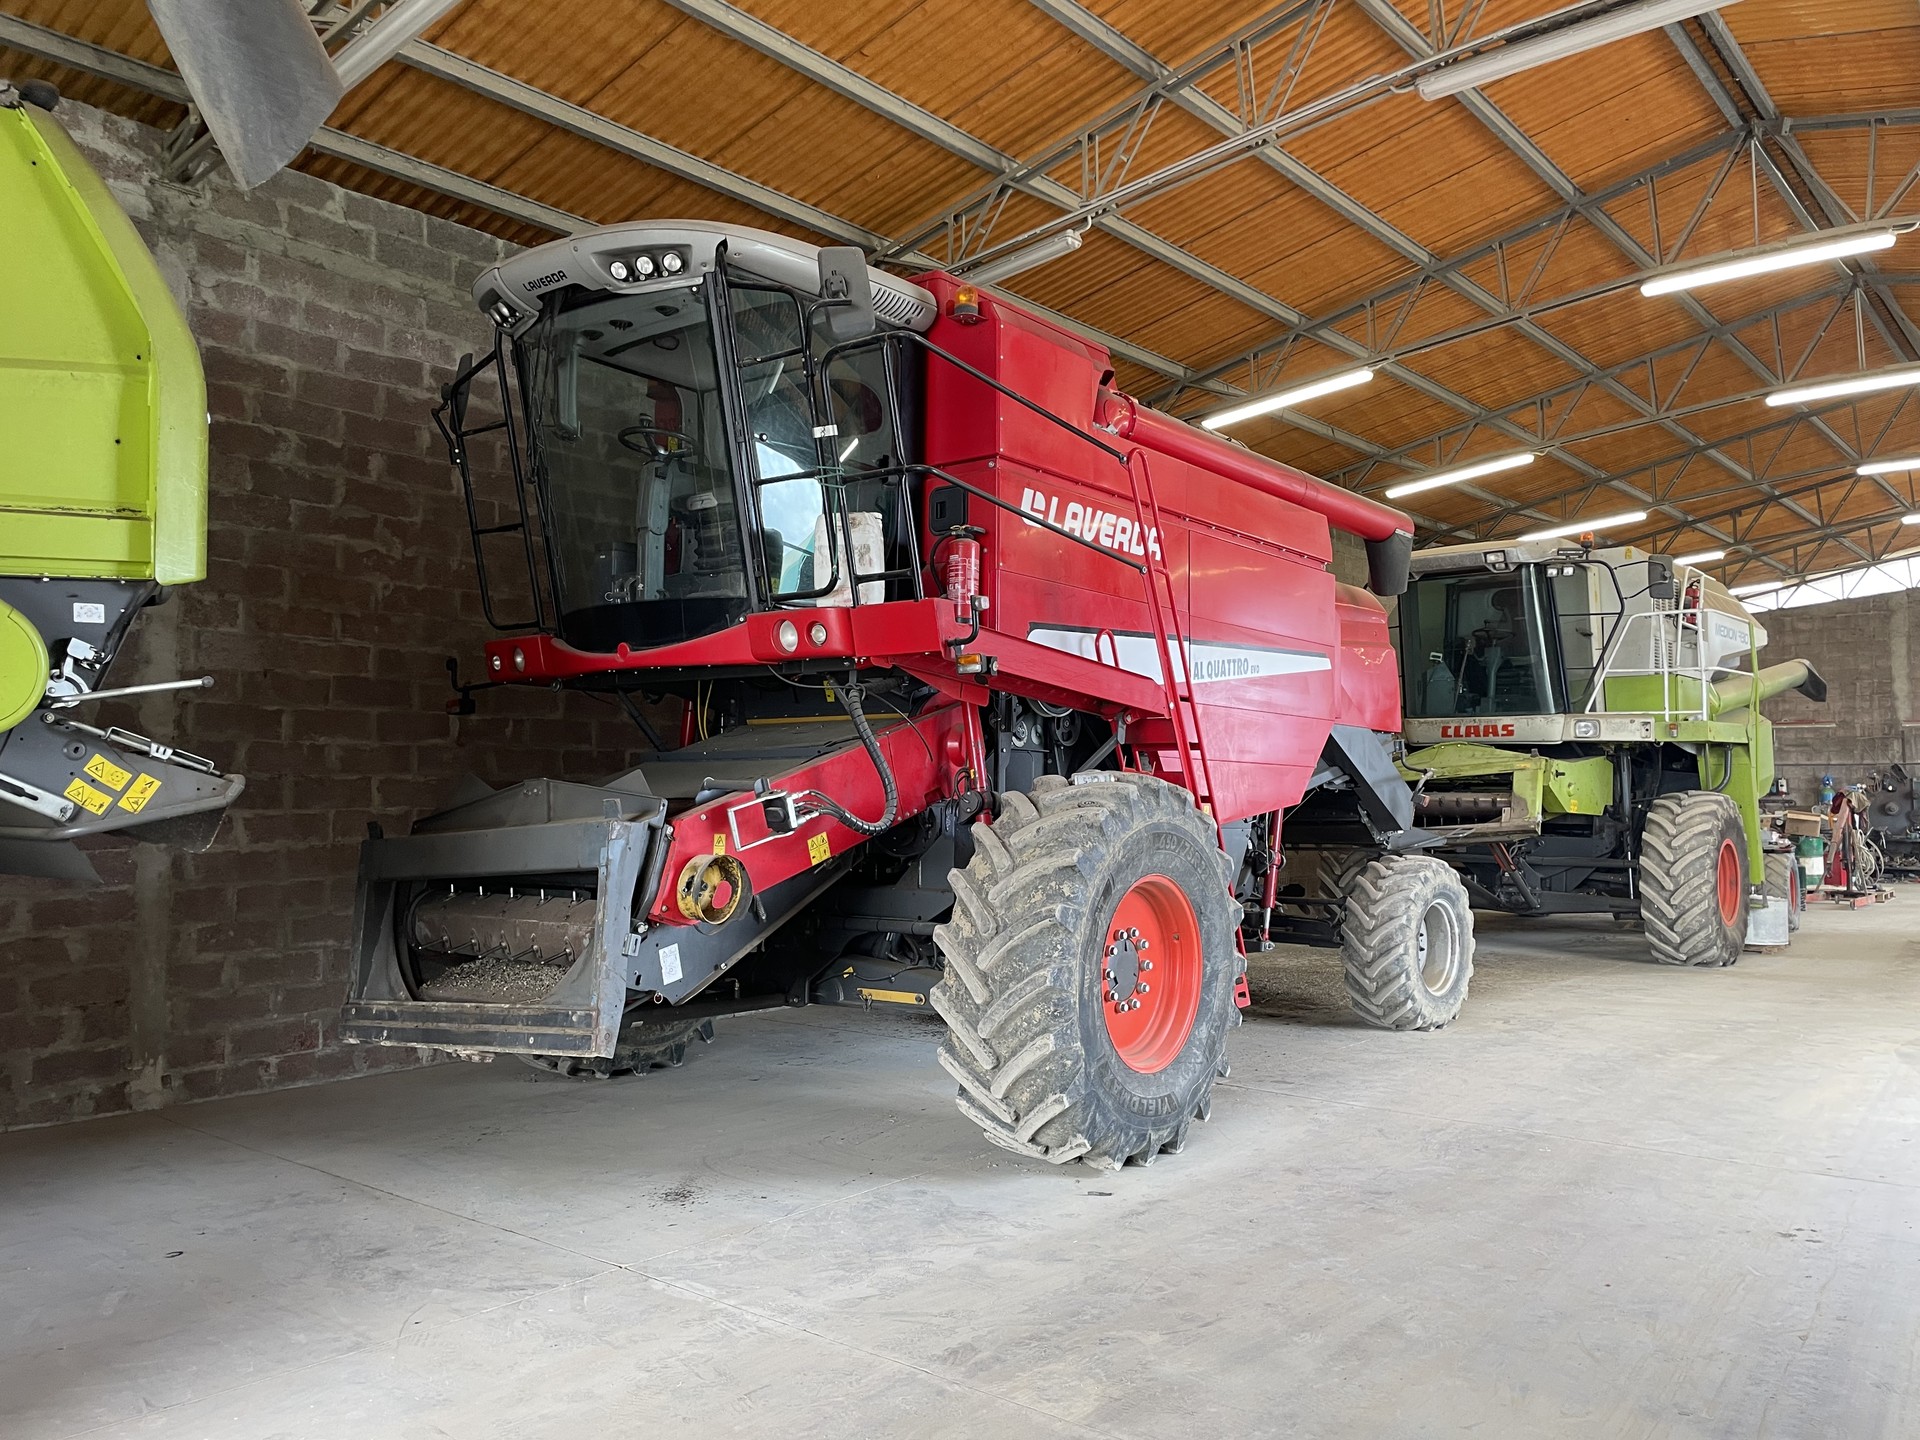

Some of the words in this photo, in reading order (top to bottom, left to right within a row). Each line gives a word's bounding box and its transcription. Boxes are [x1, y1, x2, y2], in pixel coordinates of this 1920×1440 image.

[522, 269, 568, 291] LAVERDA
[1047, 495, 1165, 562] LAVERDA
[1193, 661, 1205, 680] AL
[1207, 658, 1249, 680] QUATTRO
[1441, 724, 1515, 738] CLAAS
